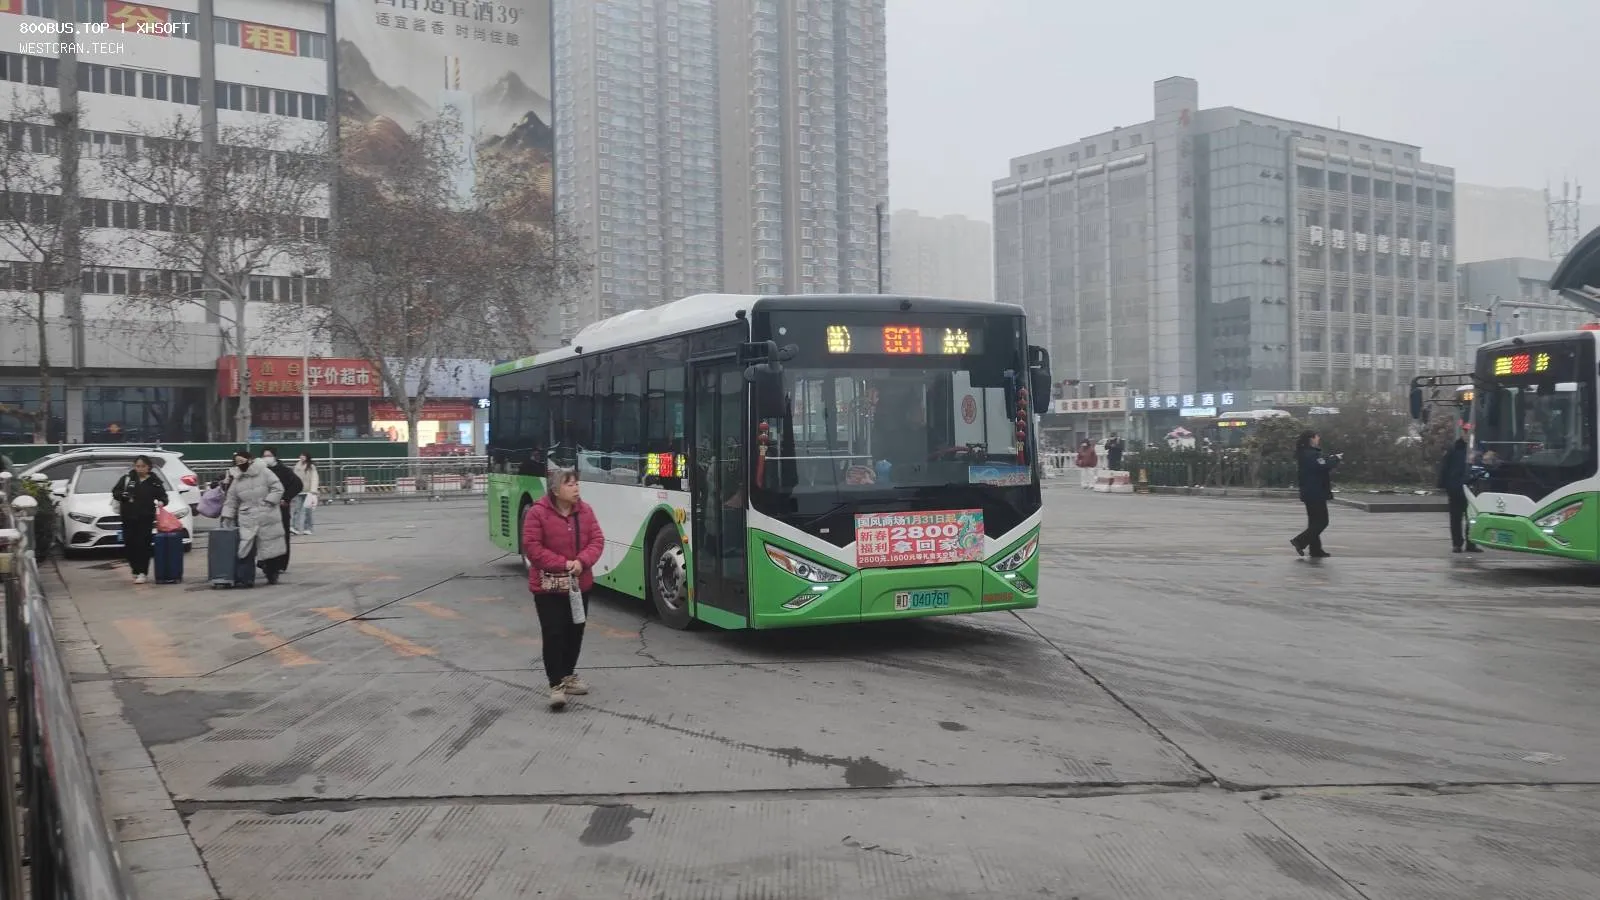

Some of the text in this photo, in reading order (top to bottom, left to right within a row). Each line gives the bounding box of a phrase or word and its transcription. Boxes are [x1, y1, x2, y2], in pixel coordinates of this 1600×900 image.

[246, 26, 296, 54] 租
[884, 326, 923, 353] 801
[308, 367, 370, 387] 平价超市
[1134, 392, 1234, 409] 居家快捷酒店
[860, 530, 886, 541] 新春
[890, 524, 959, 540] 2800
[860, 543, 887, 554] 福利
[892, 539, 960, 553] 拿回家
